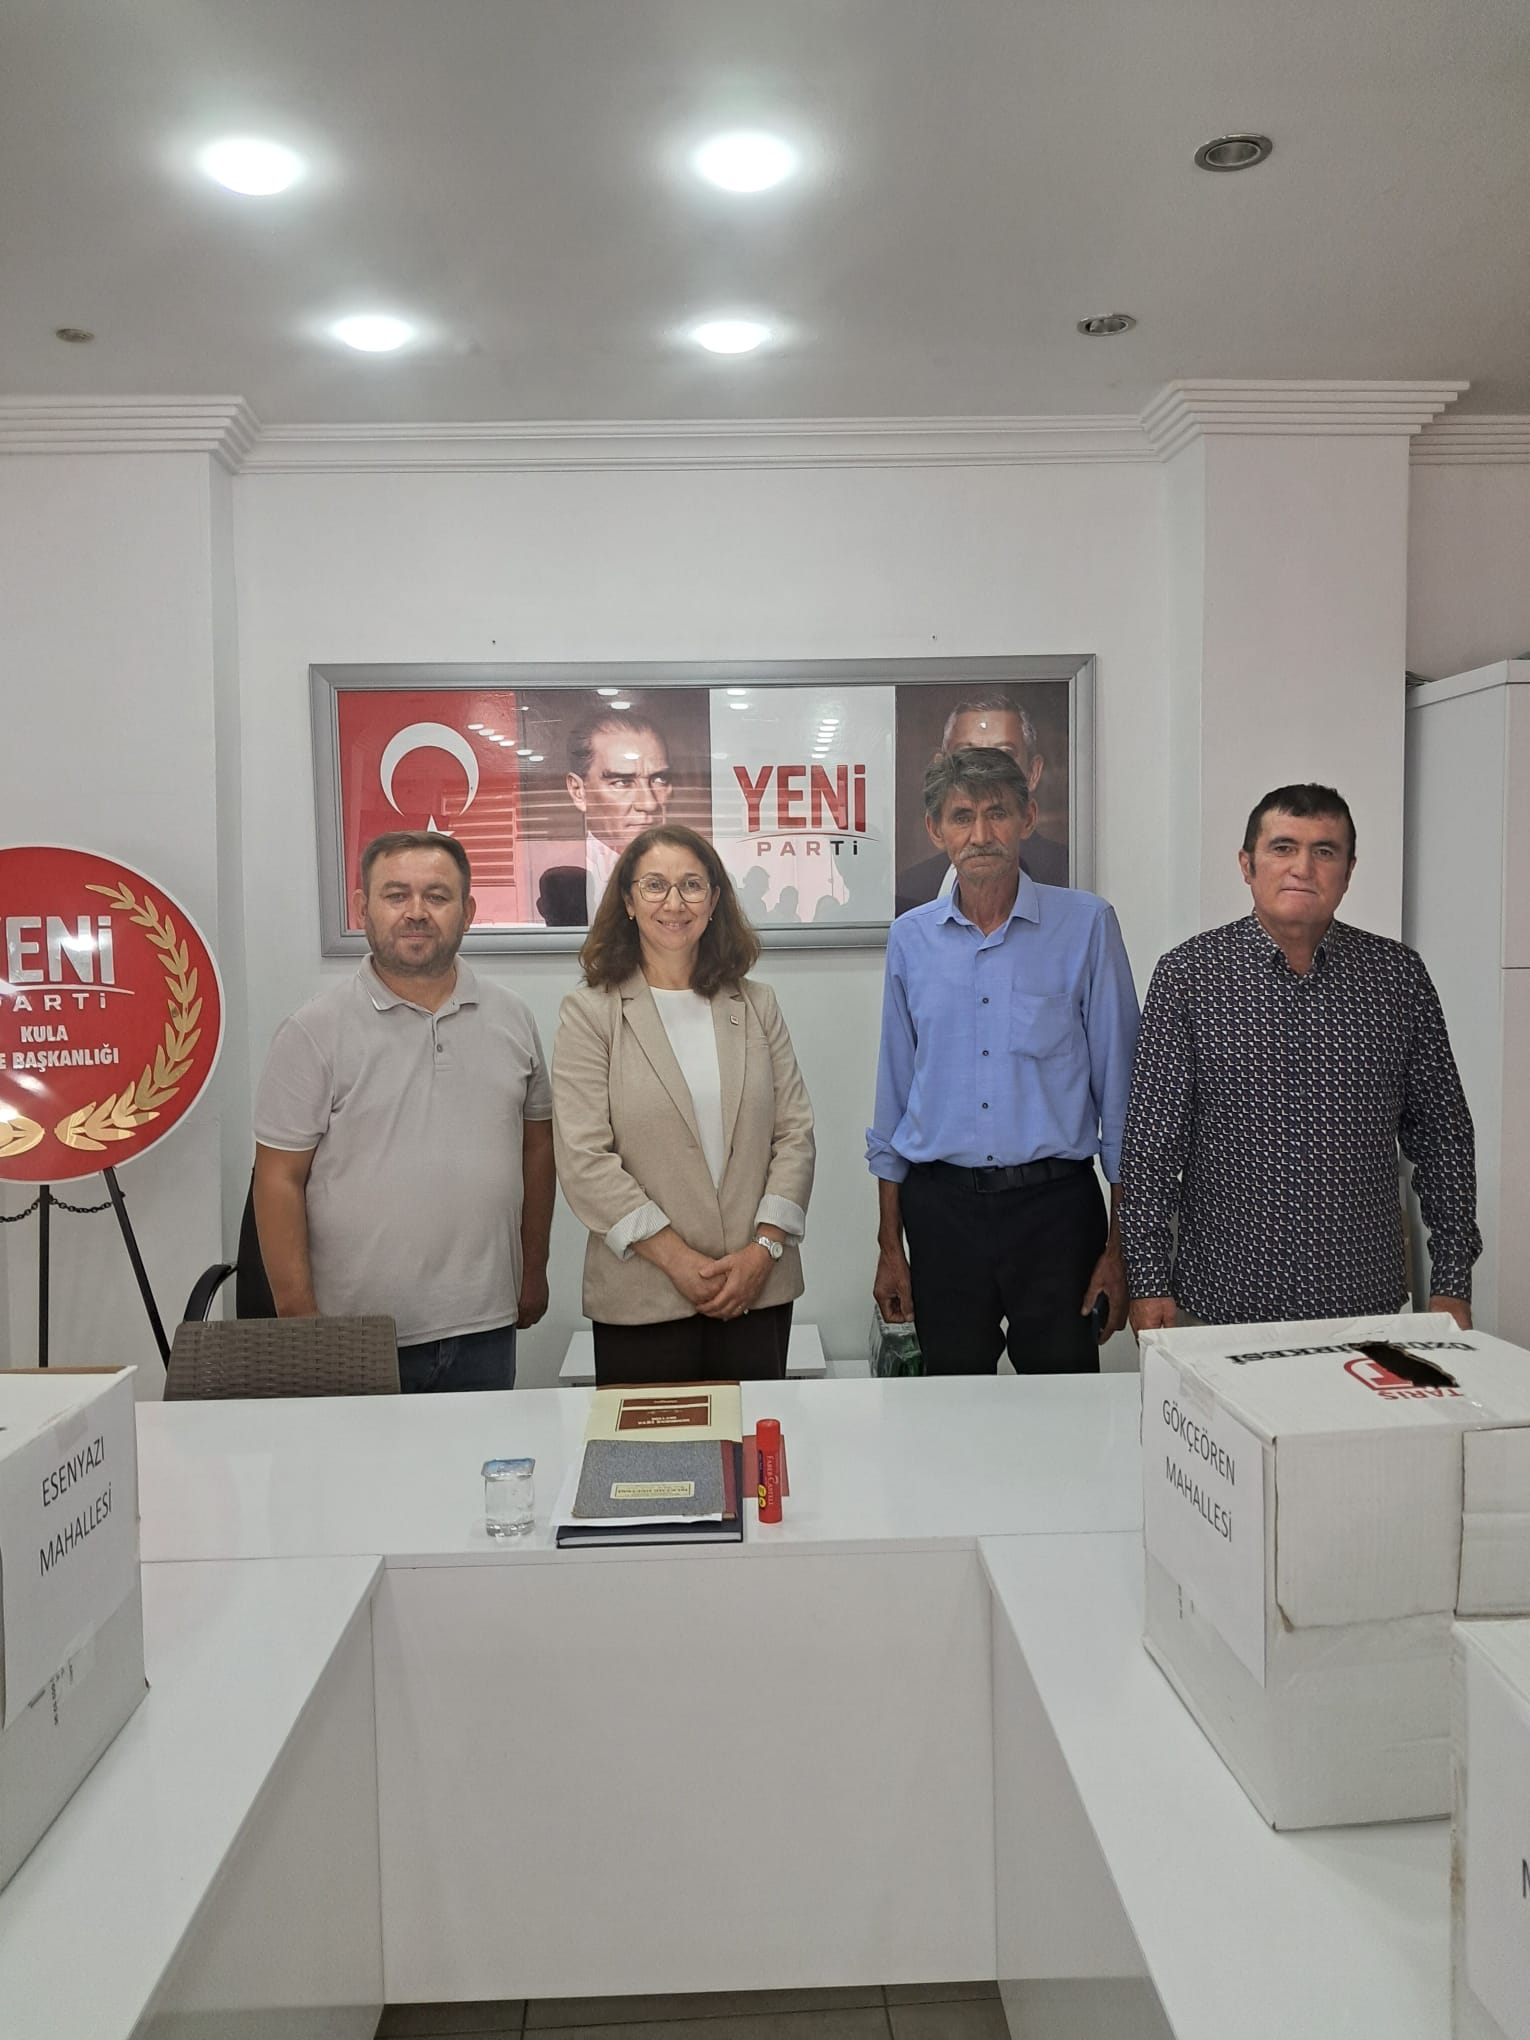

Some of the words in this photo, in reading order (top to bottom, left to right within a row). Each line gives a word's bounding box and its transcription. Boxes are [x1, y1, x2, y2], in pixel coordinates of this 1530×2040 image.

[12, 1042, 119, 1073] BAŞKANLIĞI
[20, 1024, 69, 1043] KULA
[41, 1435, 105, 1507] ESENYAZI
[1162, 1399, 1235, 1486] GÖKÇEÖREN
[39, 1482, 112, 1576] MAHALLESİ
[1166, 1455, 1232, 1543] MAHALLESİ
